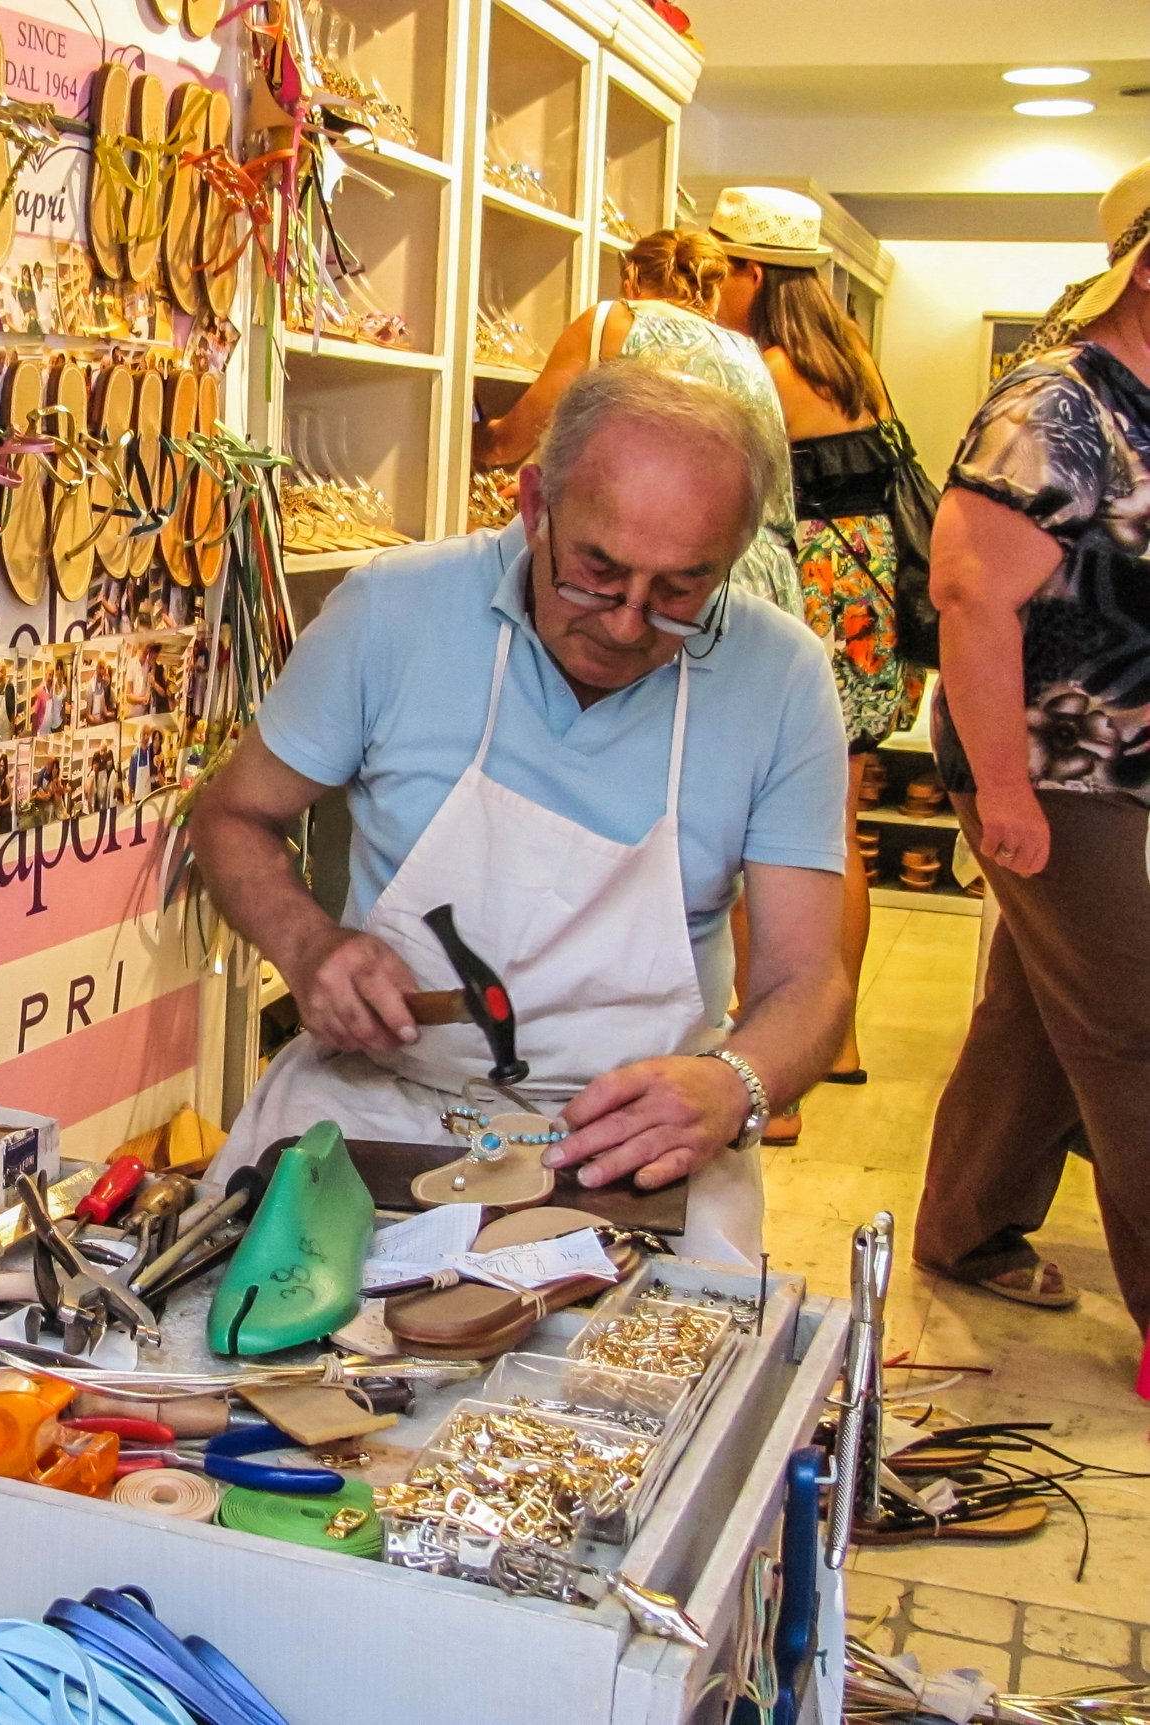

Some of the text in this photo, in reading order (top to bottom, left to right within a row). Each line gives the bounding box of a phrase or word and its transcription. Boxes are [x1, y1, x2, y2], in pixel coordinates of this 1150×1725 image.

[17, 21, 67, 59] SINCE
[5, 59, 77, 102] DAL 1964
[15, 186, 66, 233] apri
